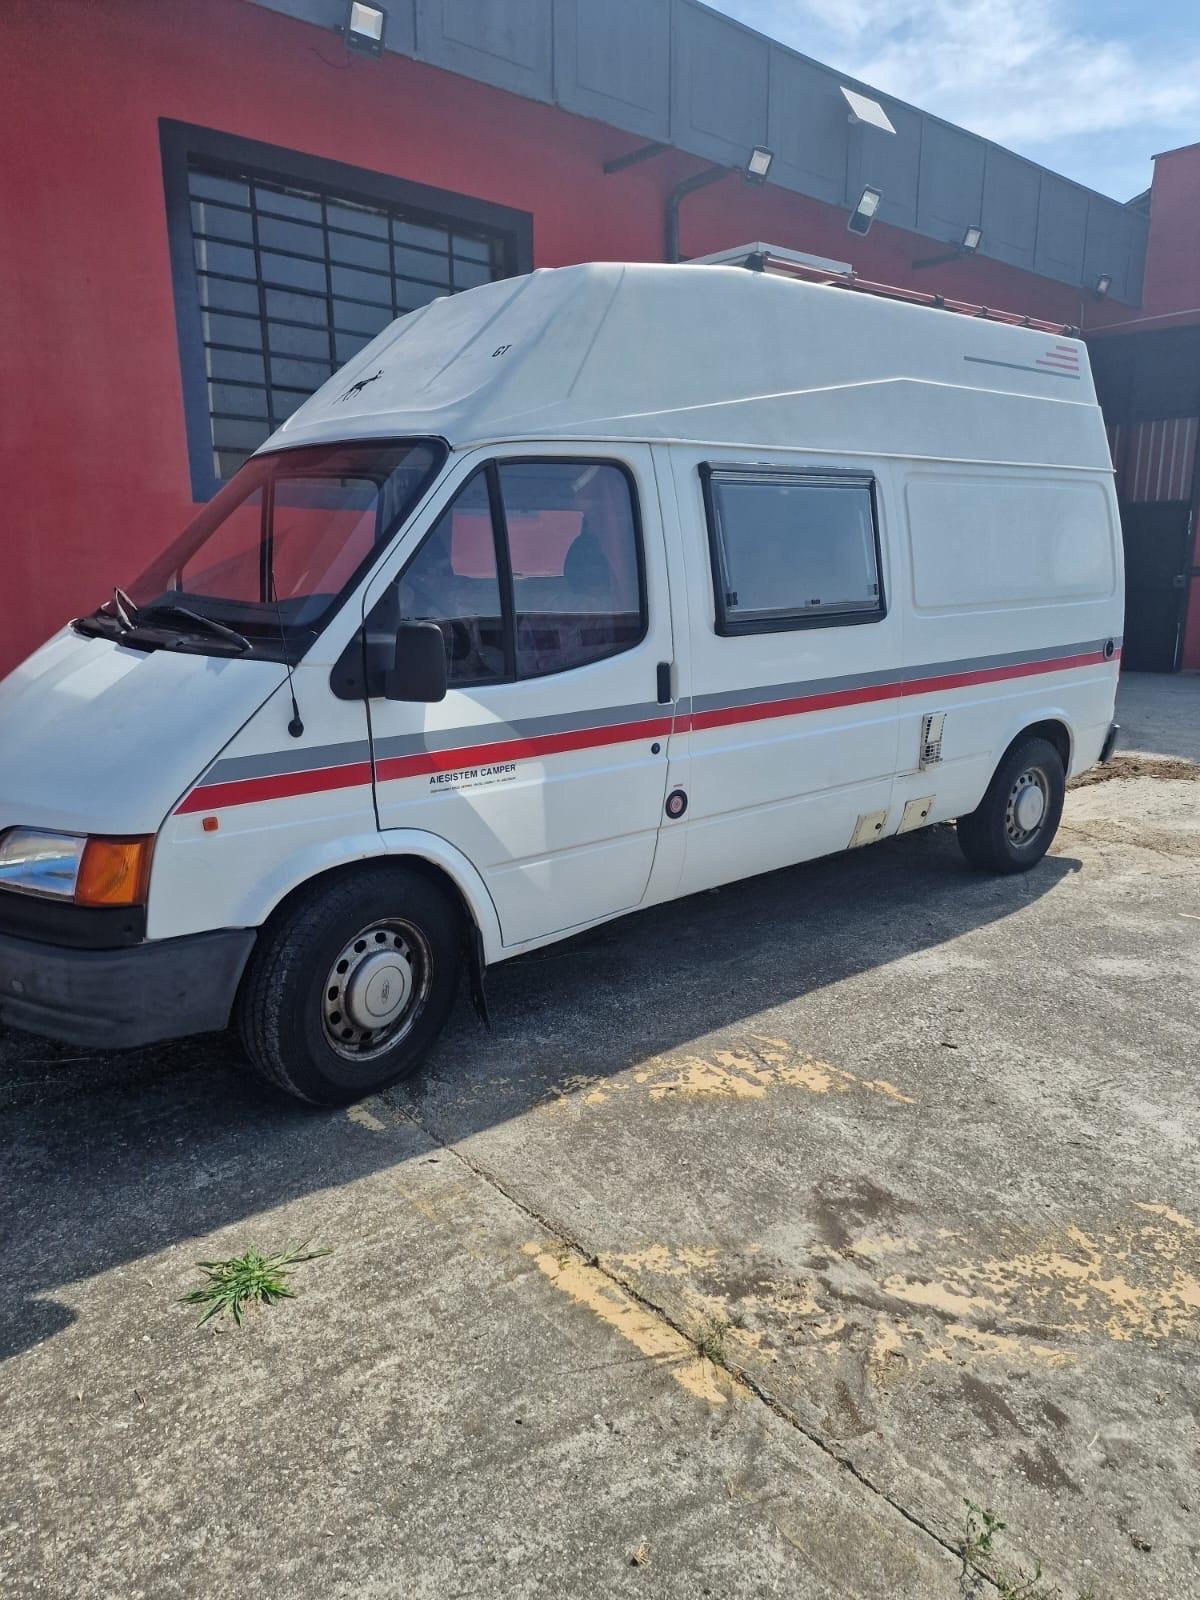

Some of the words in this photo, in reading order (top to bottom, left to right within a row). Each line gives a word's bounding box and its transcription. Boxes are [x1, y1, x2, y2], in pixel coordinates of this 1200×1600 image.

[491, 344, 512, 357] GT
[429, 770, 478, 785] AIESISTEM
[480, 764, 516, 777] CAMPER
